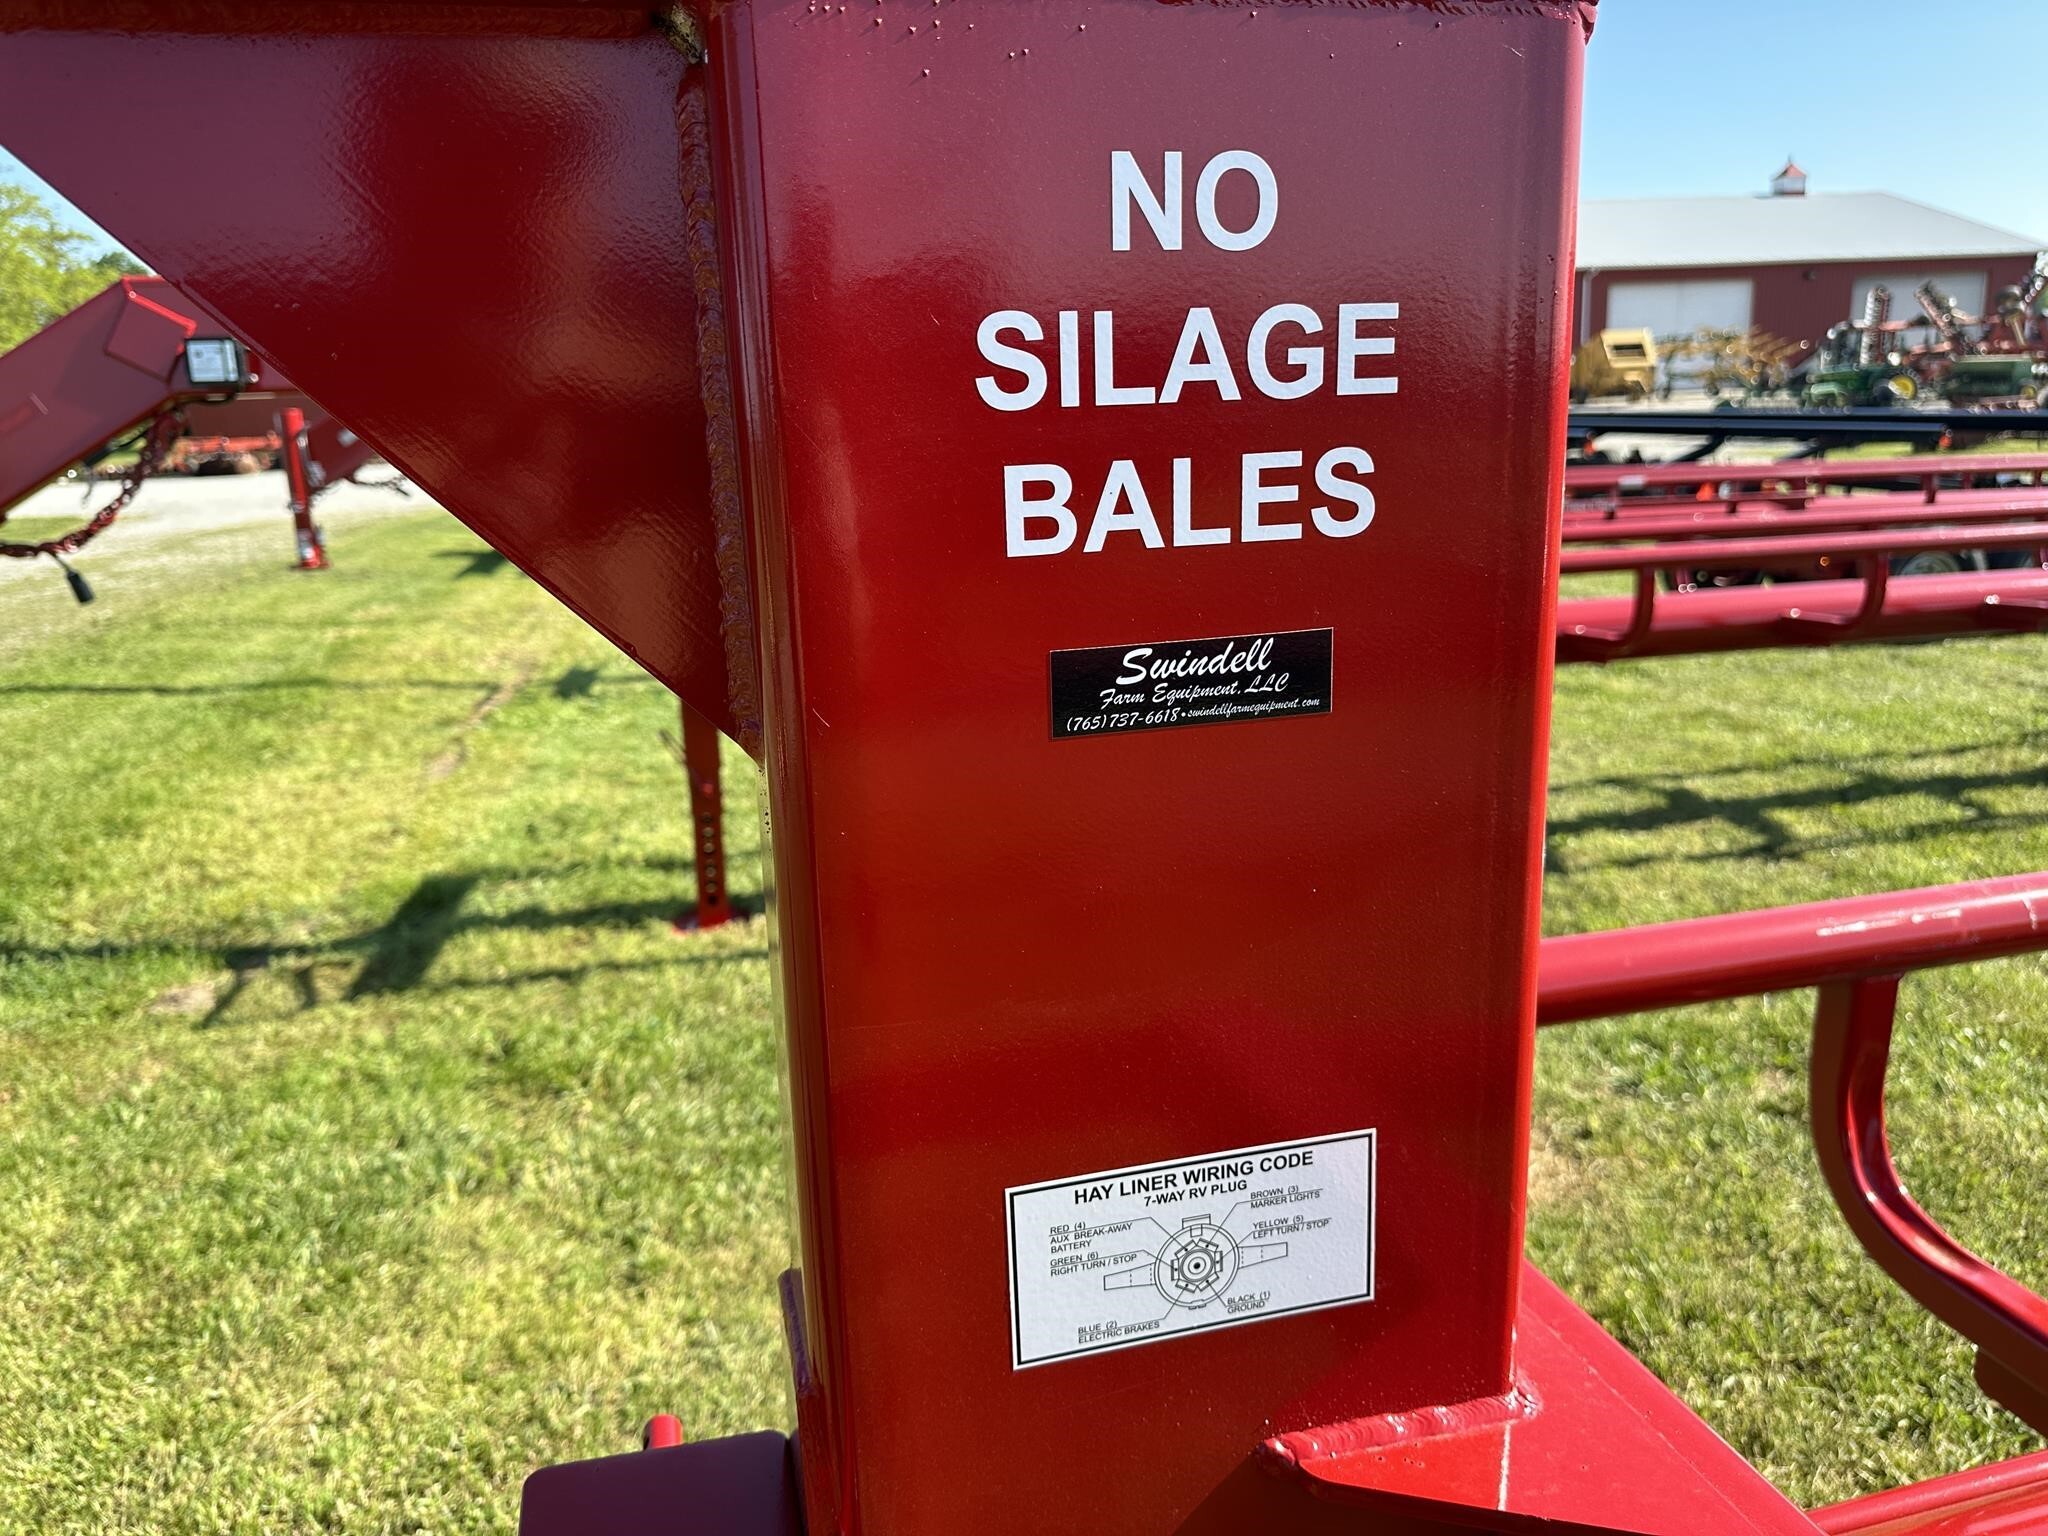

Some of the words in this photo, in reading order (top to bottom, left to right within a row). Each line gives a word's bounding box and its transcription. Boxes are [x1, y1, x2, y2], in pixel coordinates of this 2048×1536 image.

[1112, 150, 1278, 251] NO
[975, 302, 1400, 411] SILAGE
[1004, 447, 1376, 557] BALES
[1116, 637, 1274, 685] Swindell
[1100, 688, 1145, 710] Farm
[1244, 672, 1290, 693] LLC
[1074, 1183, 1114, 1205] HAY
[1119, 1173, 1178, 1197] LINER
[1183, 1161, 1254, 1185] WIRING
[1259, 1150, 1314, 1172] CODE
[1144, 1190, 1186, 1207] 7-WAY
[1189, 1186, 1207, 1199] RV
[1211, 1180, 1248, 1195] PLUG
[1250, 1187, 1284, 1200] BROWN
[1287, 1185, 1299, 1196] (3)
[1250, 1196, 1288, 1209] MARKER
[1289, 1191, 1321, 1203] LIGHTS
[1050, 1224, 1070, 1235] RED
[1074, 1221, 1087, 1232] (4)
[1252, 1217, 1289, 1230] YELLOW
[1292, 1214, 1305, 1225] (5)
[1252, 1227, 1274, 1240] LEFT
[1276, 1224, 1300, 1236] TURN
[1306, 1219, 1330, 1231] STOP
[1050, 1233, 1070, 1245] AUX
[1073, 1222, 1133, 1240] BREAK-AWAY
[1051, 1239, 1092, 1254] BATTERY
[1050, 1255, 1083, 1268] GREEN
[1087, 1251, 1099, 1262] (6)
[1050, 1265, 1079, 1277] RIGHT
[1081, 1260, 1106, 1273] TURN
[1112, 1253, 1138, 1265] STOP
[1227, 1294, 1256, 1305] BLACK
[1227, 1301, 1266, 1314] GROUND
[1078, 1323, 1101, 1335] BLUE
[1105, 1320, 1118, 1330] (2)
[1078, 1328, 1122, 1344] ELECTRIC
[1124, 1320, 1160, 1335] BRAKES
